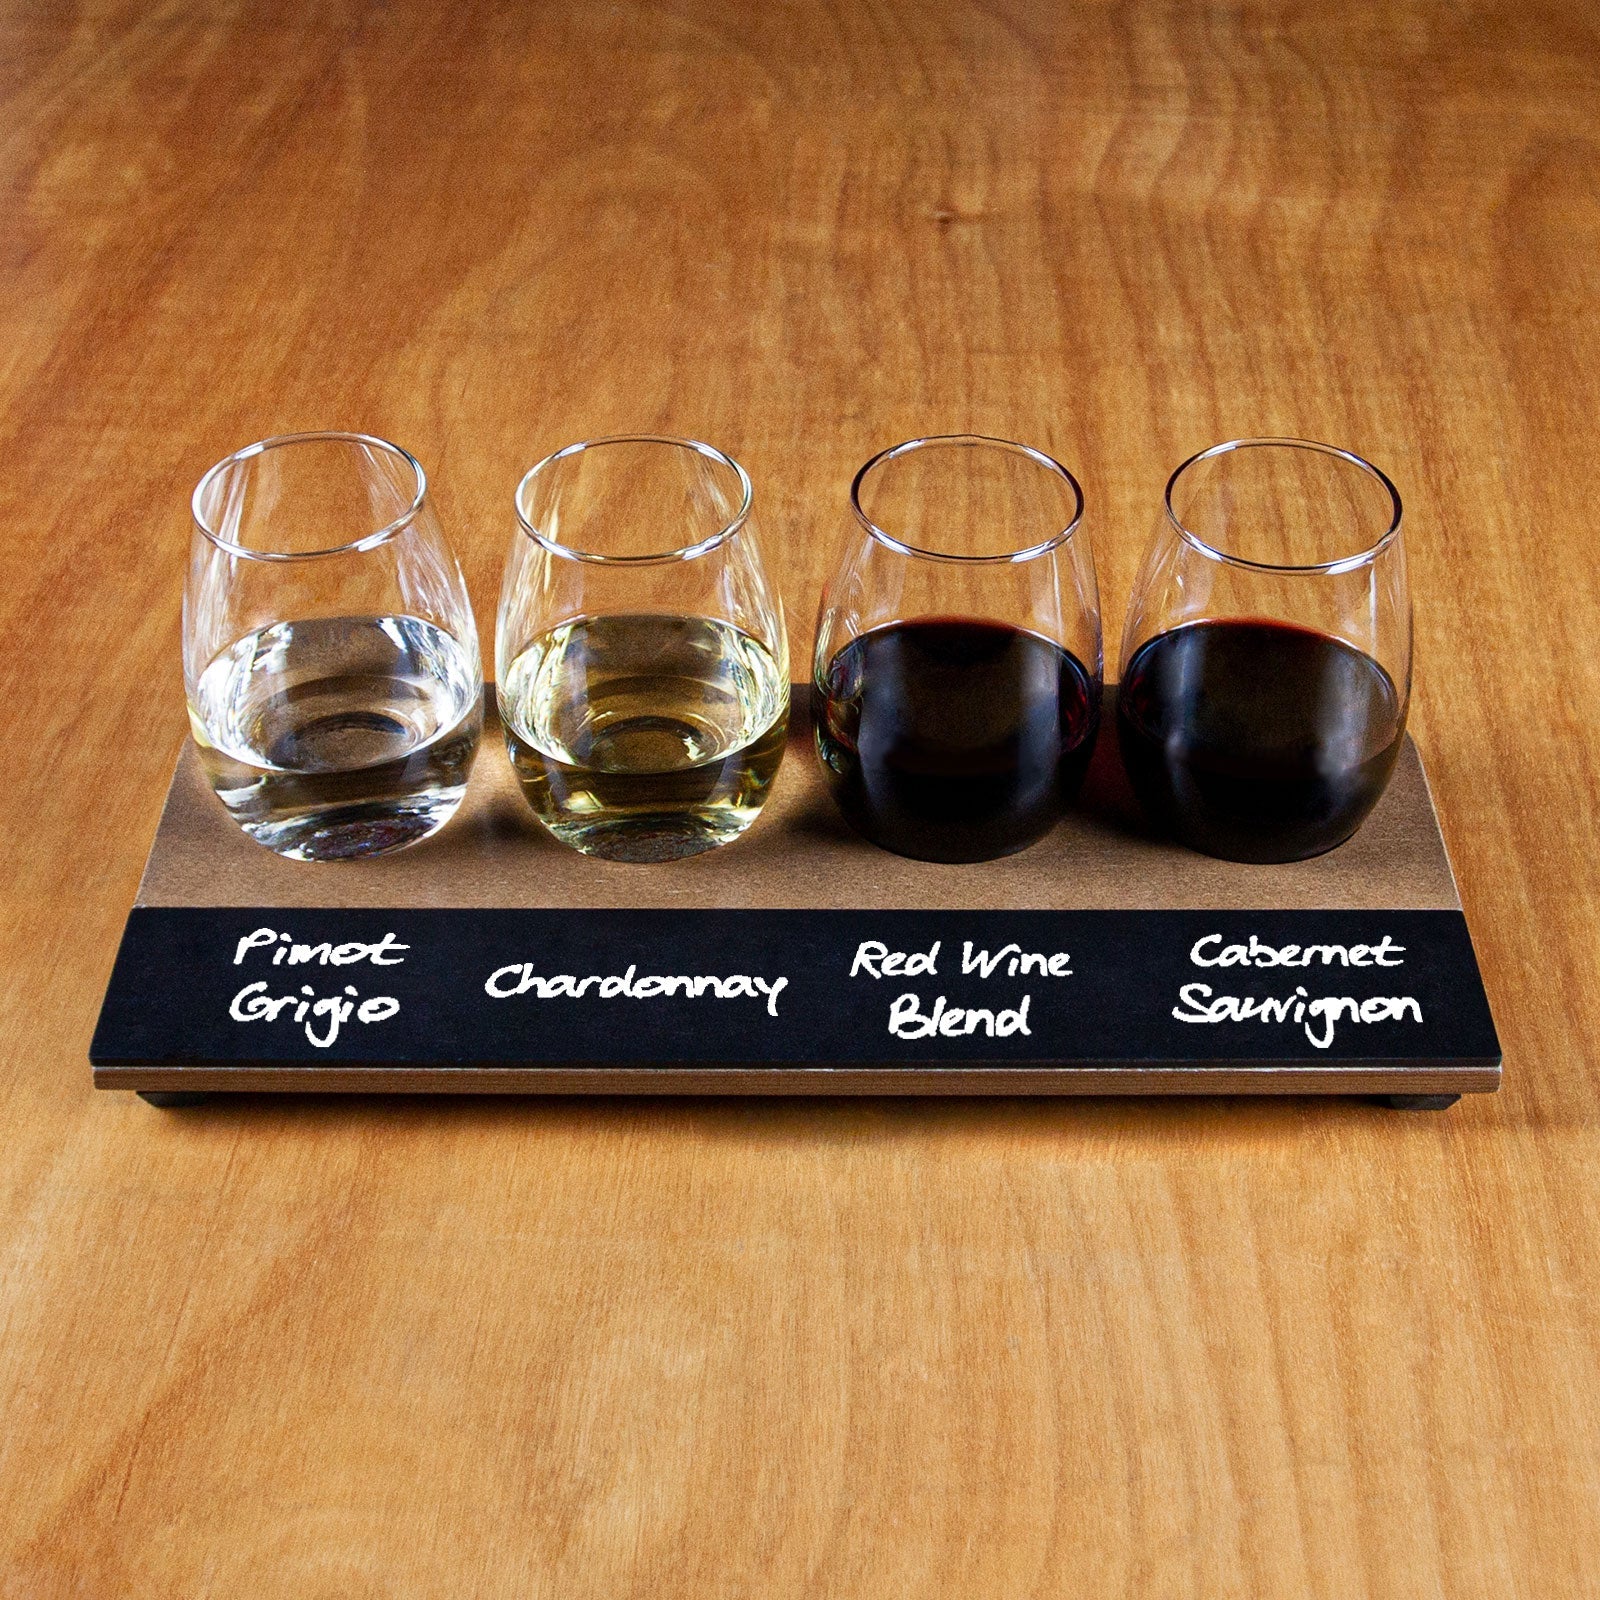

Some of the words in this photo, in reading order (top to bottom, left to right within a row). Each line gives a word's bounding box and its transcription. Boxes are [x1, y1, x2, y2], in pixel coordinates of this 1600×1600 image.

[850, 941, 941, 979] Red
[962, 941, 1073, 978] Wine
[1190, 934, 1406, 968] Cabernet
[229, 982, 399, 1048] Grigio
[485, 963, 788, 1017] Chardonnay
[888, 994, 1031, 1040] Blend
[1172, 983, 1423, 1049] Sauvignon
